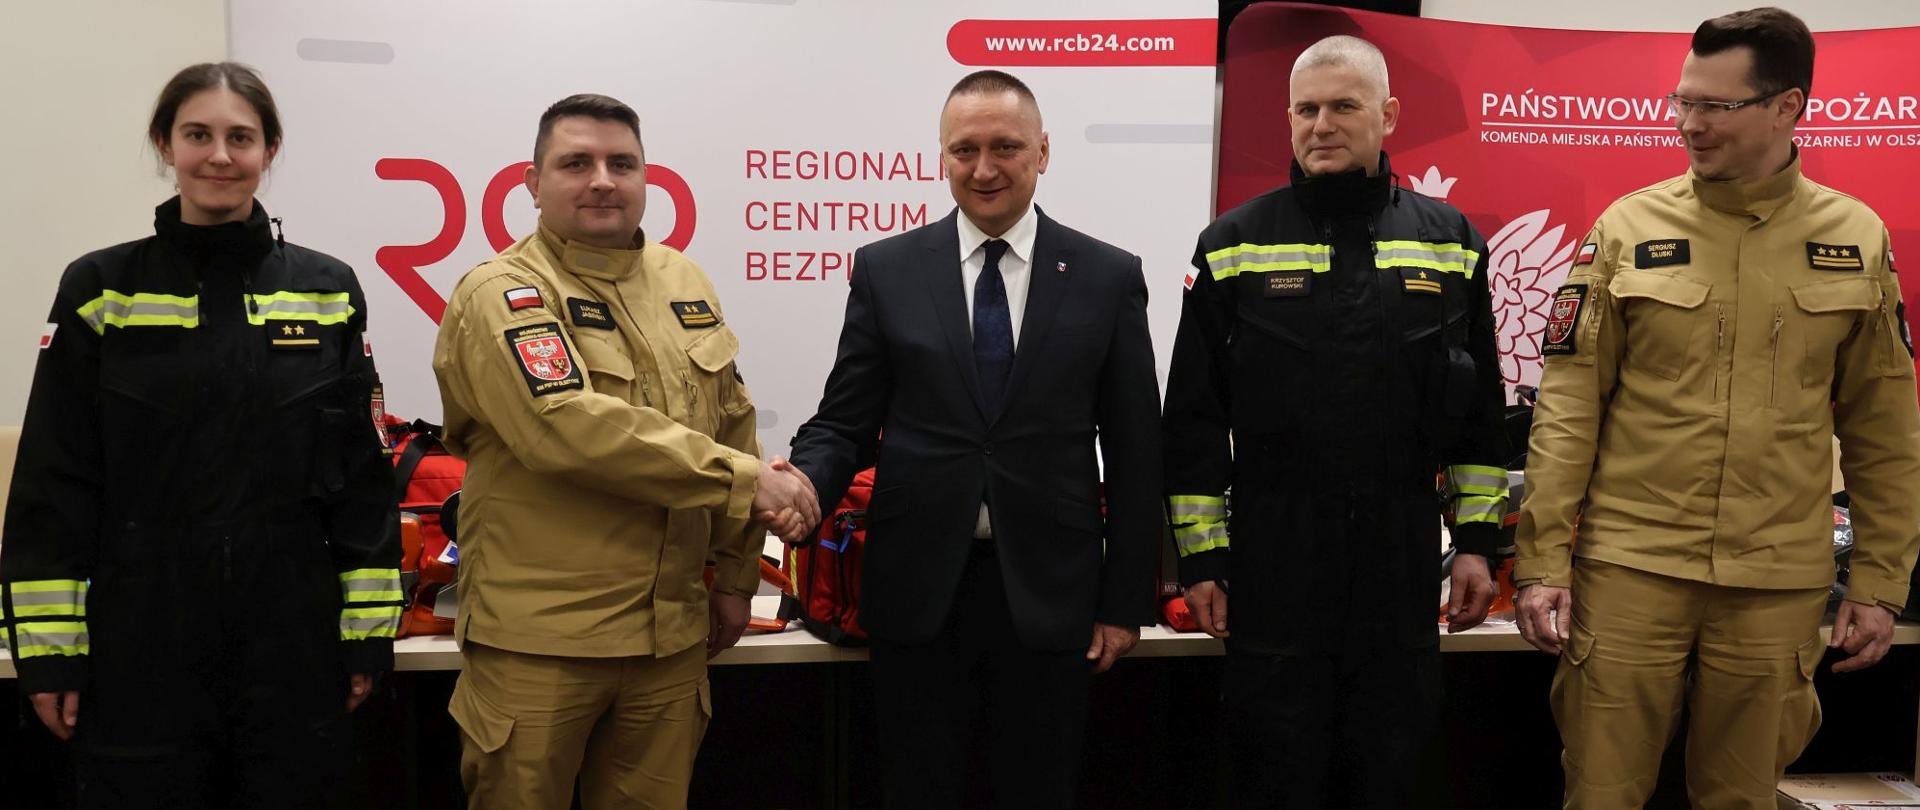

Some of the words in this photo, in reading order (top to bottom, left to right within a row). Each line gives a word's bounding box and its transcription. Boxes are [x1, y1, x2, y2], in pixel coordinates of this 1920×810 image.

[985, 33, 1175, 52] www.rcb24.com
[1482, 88, 1680, 122] PAŃSTWOWA
[1481, 130, 1549, 144] KOMENDA
[1552, 133, 1611, 146] MIEJSKA
[1791, 133, 1862, 148] OŻARNEJ
[1866, 135, 1882, 147] W
[745, 201, 927, 232] CENTRUM
[1648, 243, 1676, 252] SERGIUSZ
